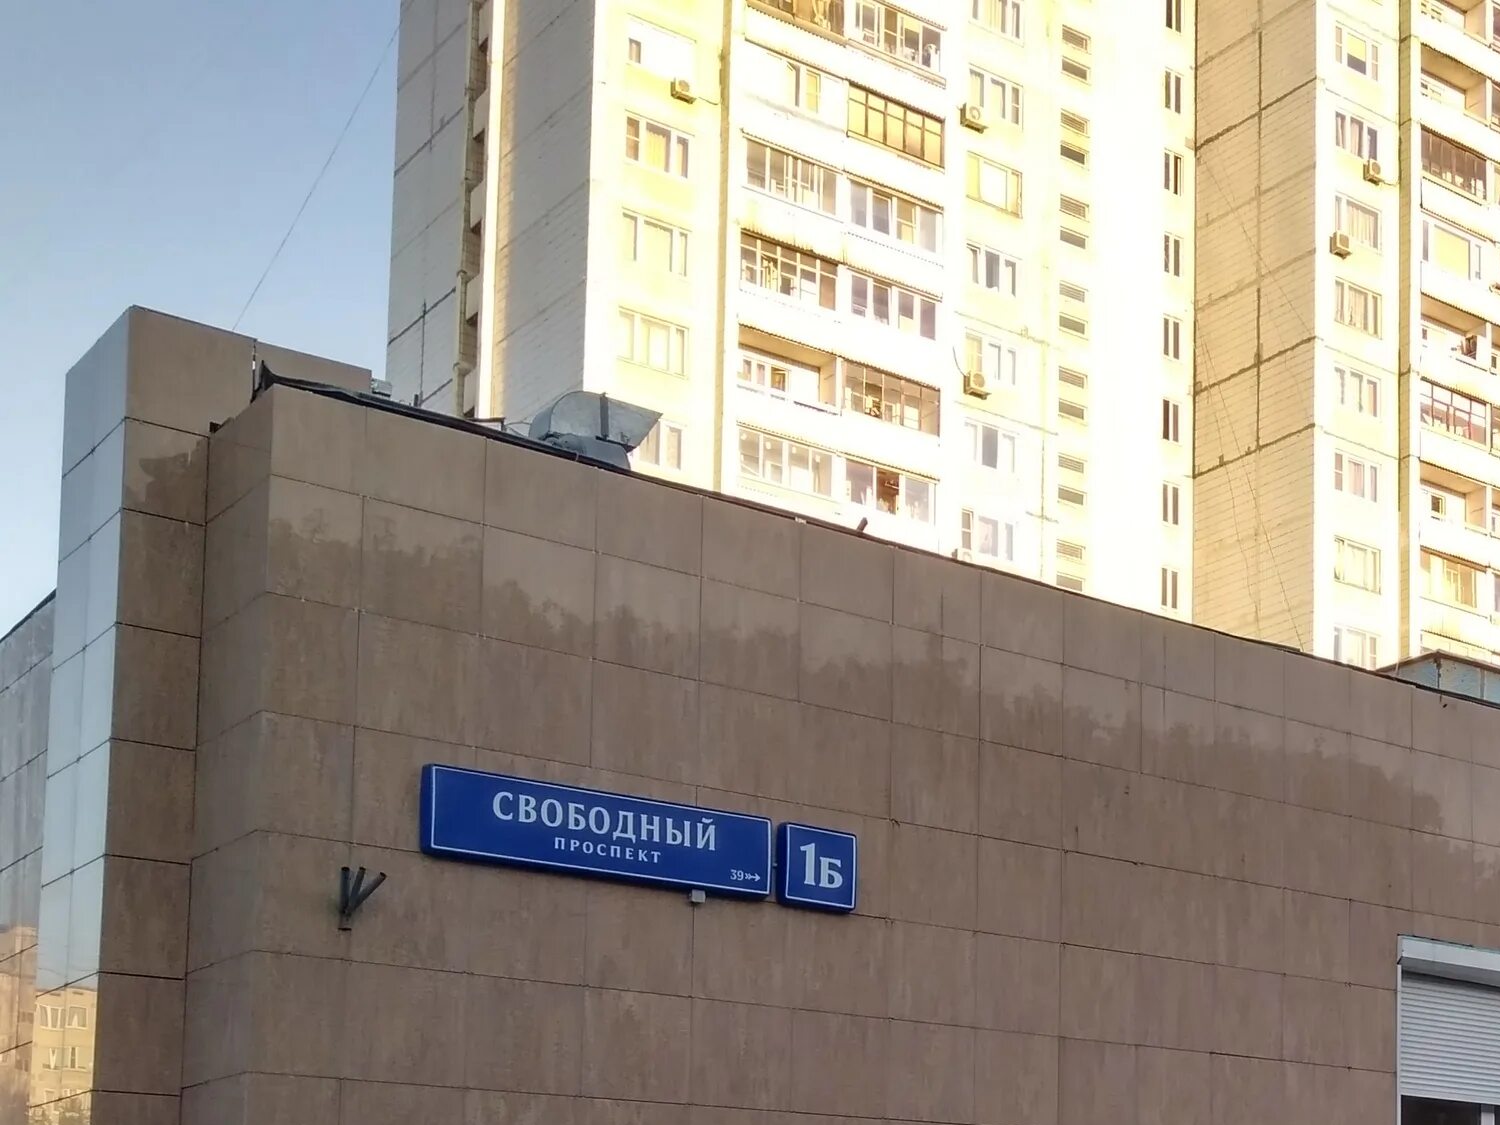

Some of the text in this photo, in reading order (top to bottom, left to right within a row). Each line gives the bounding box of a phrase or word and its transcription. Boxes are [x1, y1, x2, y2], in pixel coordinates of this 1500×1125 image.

[493, 790, 716, 852] СВОБОДНЫЙ
[554, 837, 662, 864] ПРОСПЕКТ
[799, 842, 844, 889] 1Б
[729, 868, 745, 882] 39
